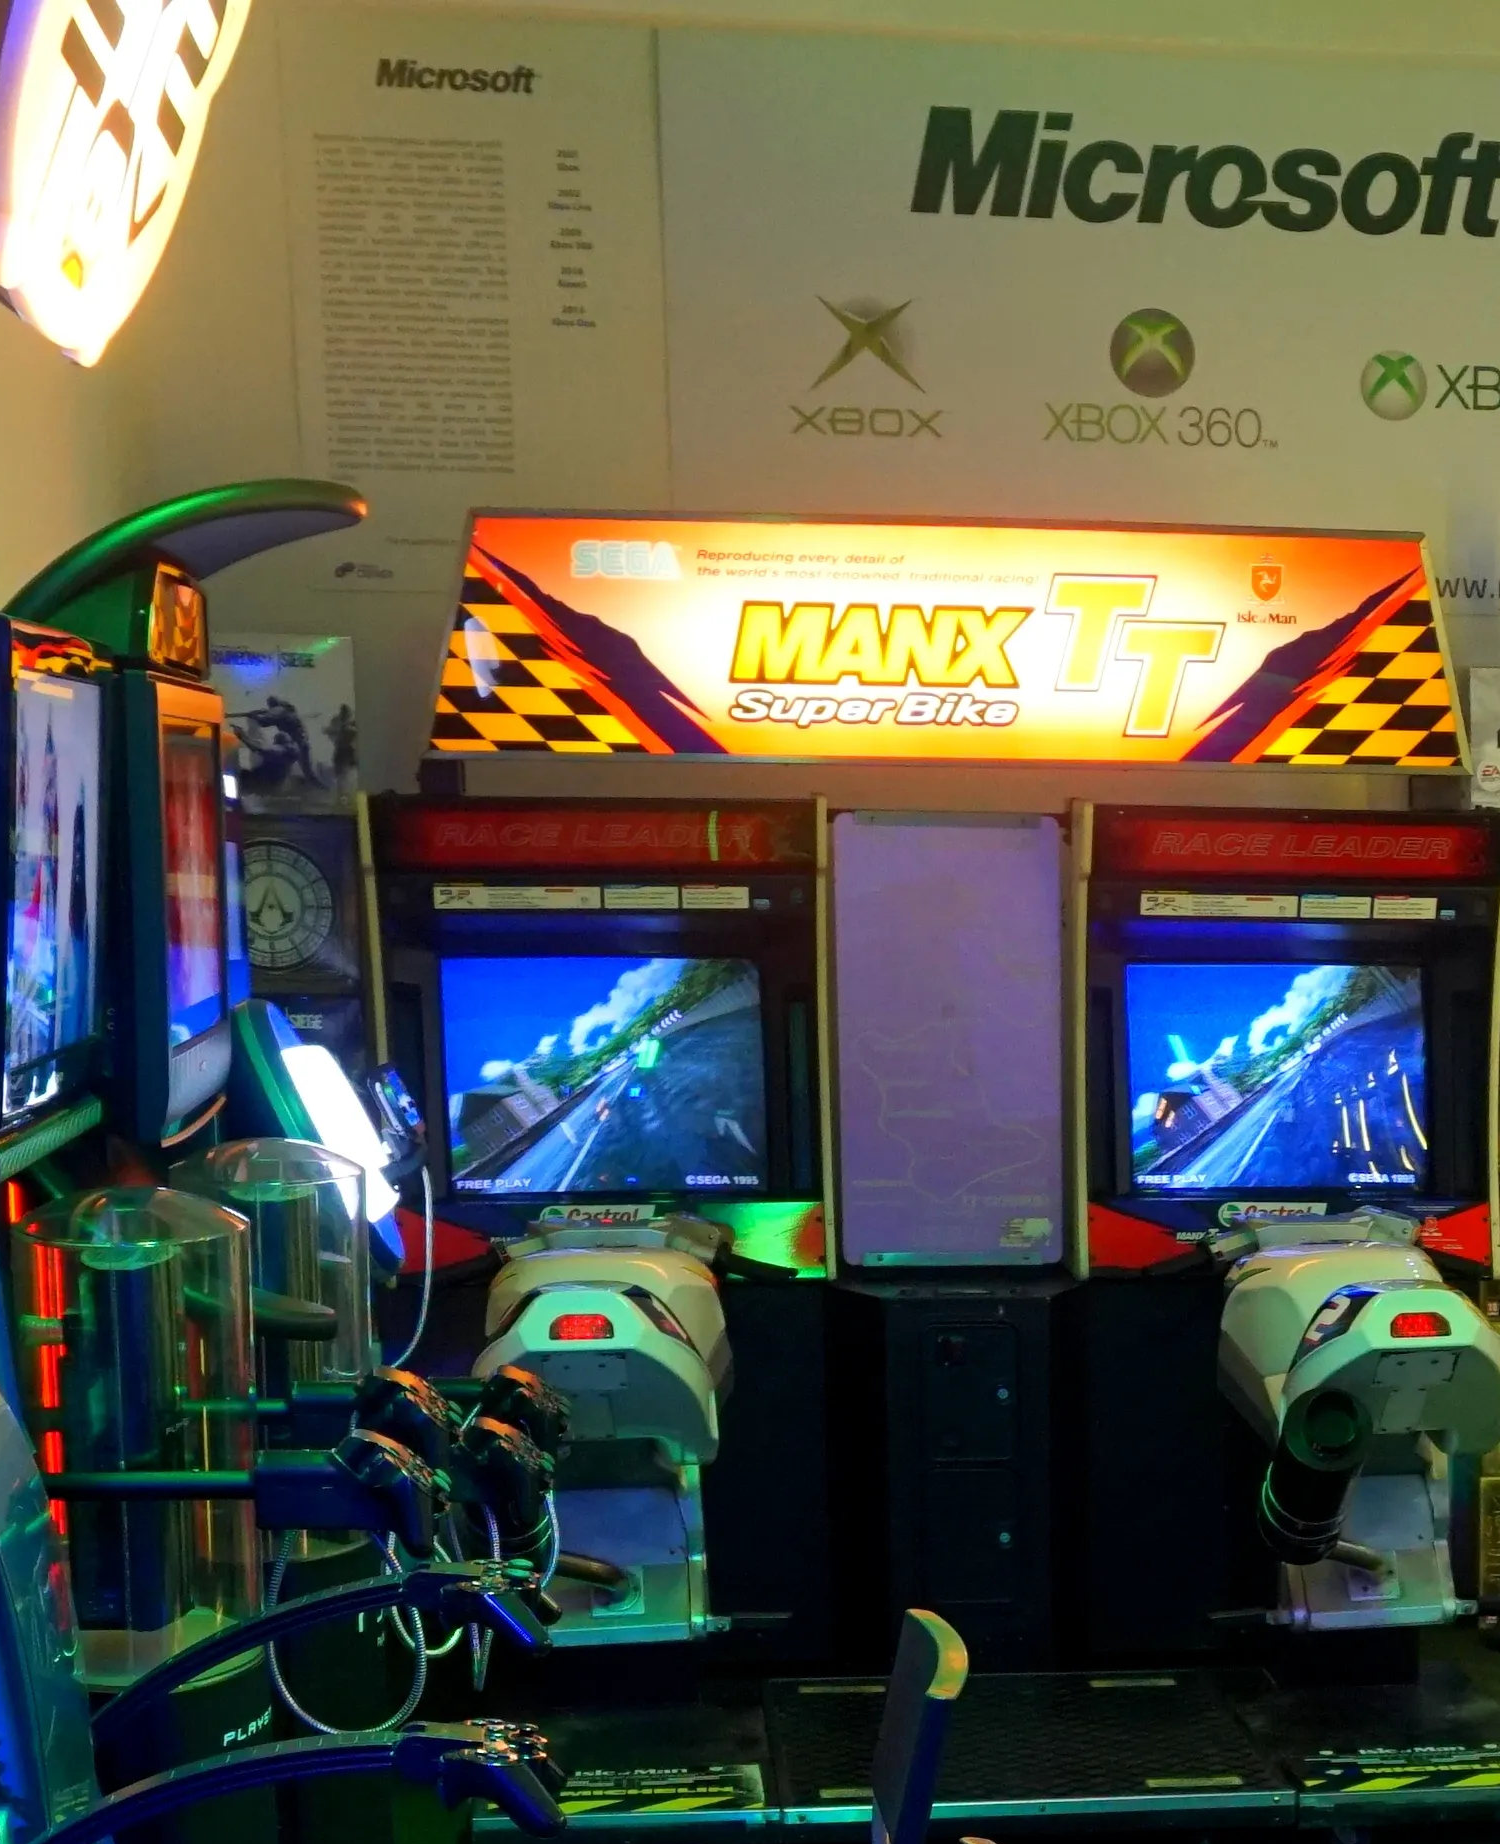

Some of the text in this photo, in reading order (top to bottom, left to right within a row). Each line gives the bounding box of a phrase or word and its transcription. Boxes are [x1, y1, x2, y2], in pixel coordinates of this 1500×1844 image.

[376, 58, 535, 94] Microsoft
[790, 406, 943, 439] XBOX
[1044, 403, 1167, 444] XBOX
[571, 540, 682, 581] SEGA
[696, 549, 906, 567] Reproducing every detail of
[696, 566, 721, 577] the
[725, 566, 780, 579] world's
[784, 569, 822, 580] most
[909, 571, 984, 584] traditional
[1236, 611, 1258, 624] Isle
[1268, 611, 1298, 625] Man
[729, 572, 1227, 738] MANX TT
[729, 689, 1019, 729] Super Bike
[436, 823, 561, 848] RACE
[1153, 831, 1452, 860] RACE LEADER
[456, 1178, 493, 1190] FREE
[495, 1177, 532, 1189] PLAY
[1136, 1174, 1170, 1185] FREE
[1172, 1174, 1208, 1184] PLAY
[564, 1206, 640, 1223] Castrol
